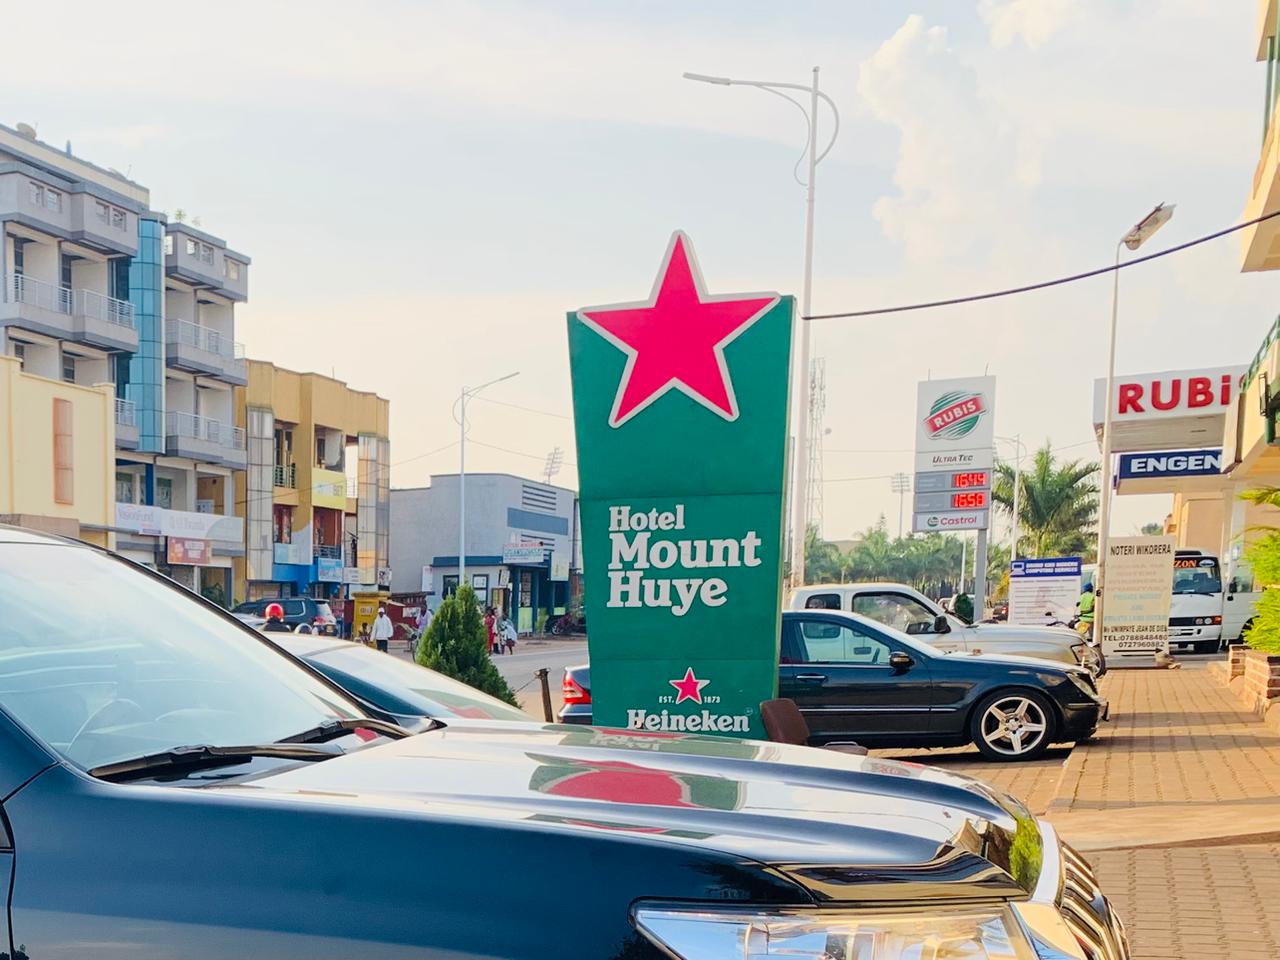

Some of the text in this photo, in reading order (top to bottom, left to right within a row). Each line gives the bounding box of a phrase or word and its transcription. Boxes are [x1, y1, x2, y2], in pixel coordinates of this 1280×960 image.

[933, 400, 978, 428] RUBIS
[1131, 455, 1222, 473] ENGEN
[956, 472, 987, 487] 1644
[608, 504, 686, 531] Hotel
[940, 516, 977, 526] Castrol
[607, 530, 762, 570] Mount
[1110, 545, 1136, 556] NOTERI
[606, 570, 729, 617] Huye
[626, 709, 750, 732] Heineken
